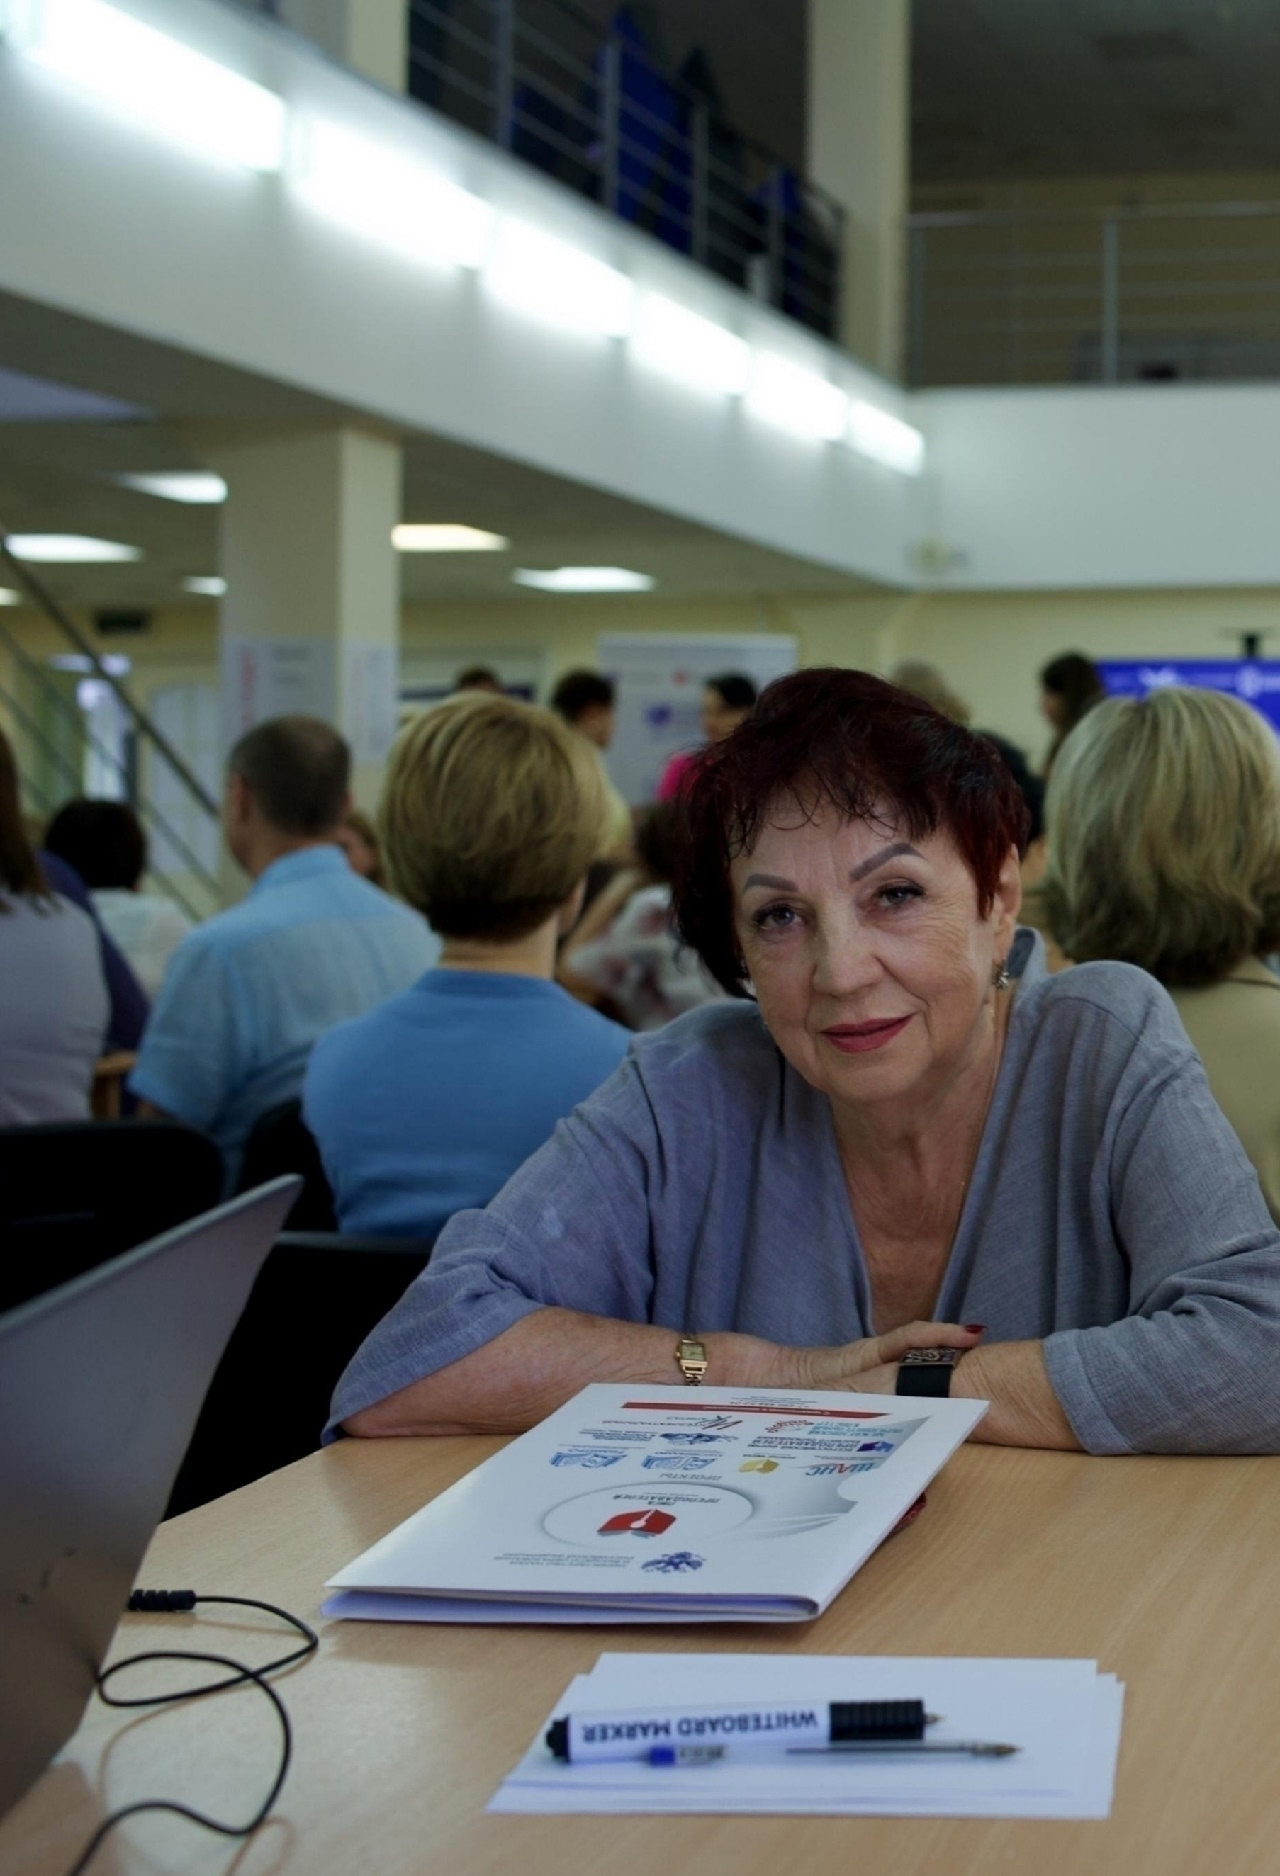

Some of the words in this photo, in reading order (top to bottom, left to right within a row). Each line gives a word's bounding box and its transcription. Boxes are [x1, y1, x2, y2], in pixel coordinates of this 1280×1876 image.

[659, 1473, 722, 1481] ПРОЕКТЫ
[804, 1462, 874, 1476] ШАНС
[582, 1720, 671, 1744] MARKER
[677, 1710, 818, 1736] WHITEBOARD
